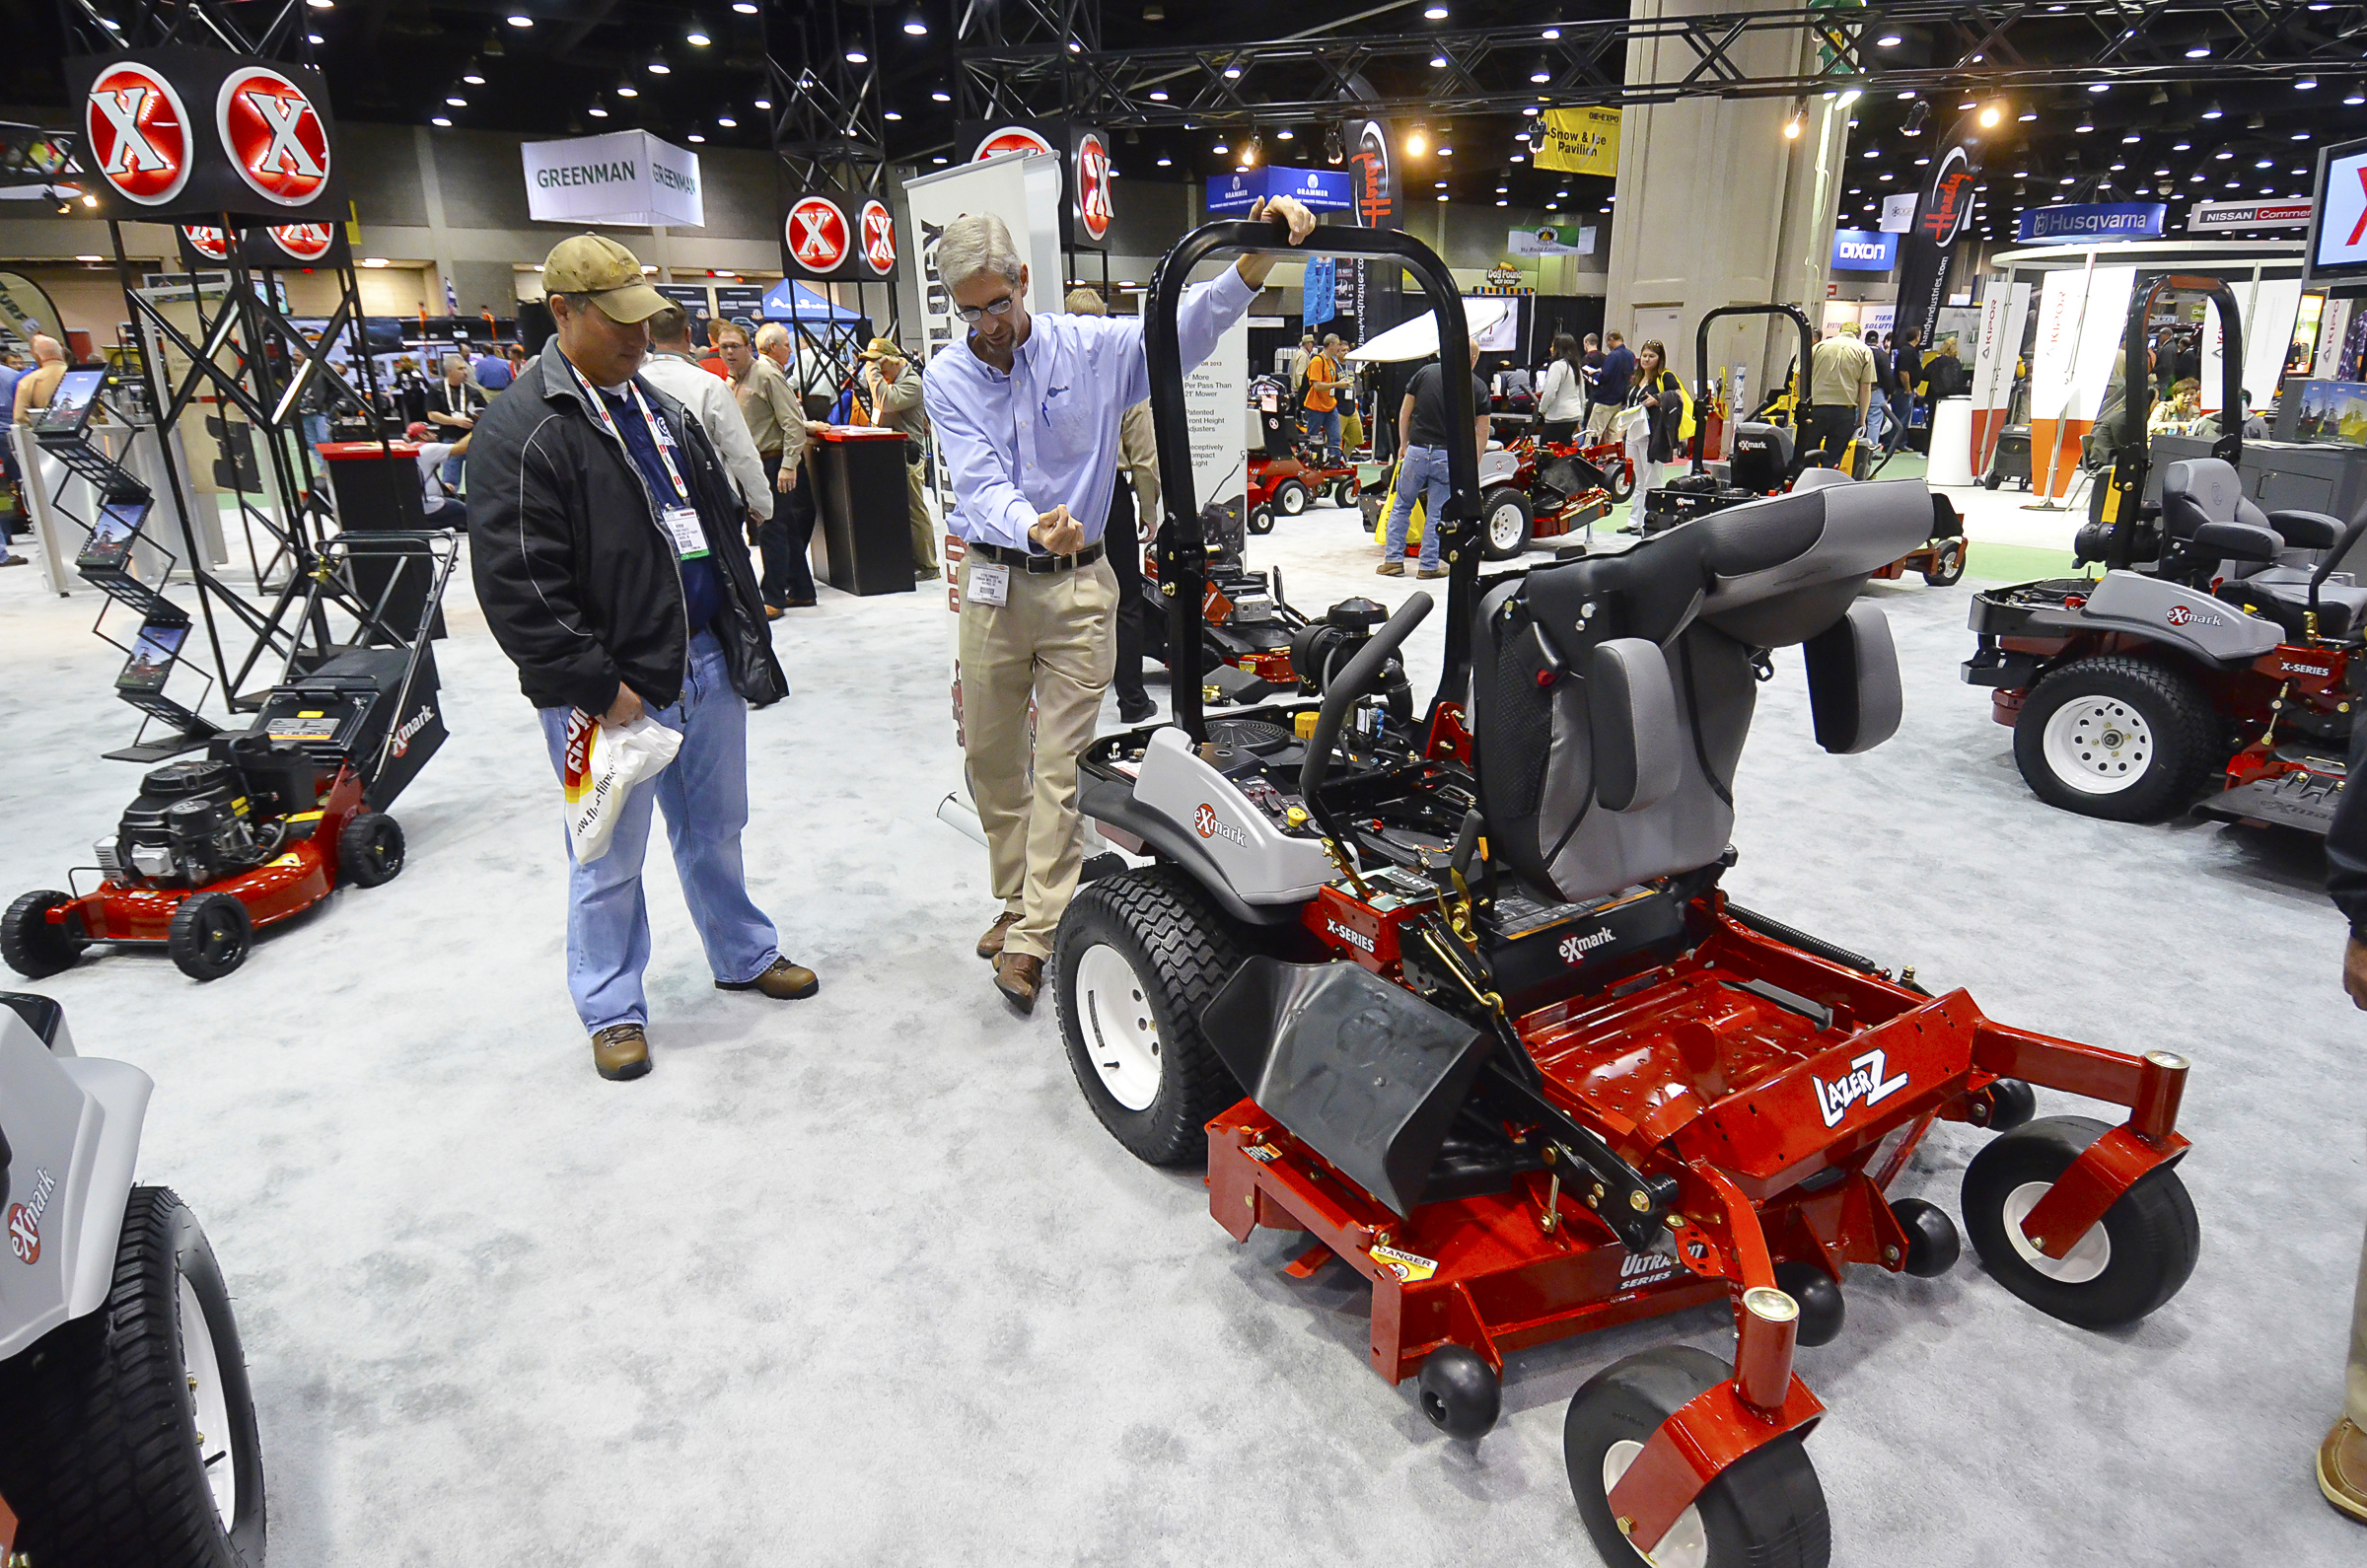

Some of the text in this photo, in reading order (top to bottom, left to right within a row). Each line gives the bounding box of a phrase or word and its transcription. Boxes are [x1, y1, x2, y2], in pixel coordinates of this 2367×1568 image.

[90, 87, 166, 176] X
[247, 91, 324, 178] X
[1550, 126, 1607, 145] Snow & Ice
[1558, 140, 1597, 157] Pavilion
[537, 161, 636, 188] GREENMAN
[652, 163, 696, 195] GREENMAN
[1093, 152, 1114, 218] X
[1924, 172, 1974, 241] Handy
[2049, 213, 2147, 232] Husqvarna
[2206, 211, 2253, 222] NISSAN
[794, 212, 836, 256] X
[866, 216, 897, 260] X
[1838, 241, 1886, 261] DIXON
[1487, 269, 1523, 280] Dog Pound
[1919, 255, 1949, 345] handyindustries.com
[1985, 299, 1998, 344] KIPOR
[1738, 440, 1767, 451] eXmark
[2166, 606, 2223, 626] eXmark
[2280, 661, 2330, 677] X-SERIES
[392, 704, 435, 756] Xmark
[1193, 806, 1247, 848] eXmark
[1327, 917, 1375, 954] X-SERIES
[1558, 927, 1616, 963] eXmark
[10, 1167, 56, 1261] eXmark
[1377, 1247, 1432, 1267] DANGER
[1619, 1253, 1671, 1278] ULTRA
[1619, 1270, 1672, 1290] SERIES
